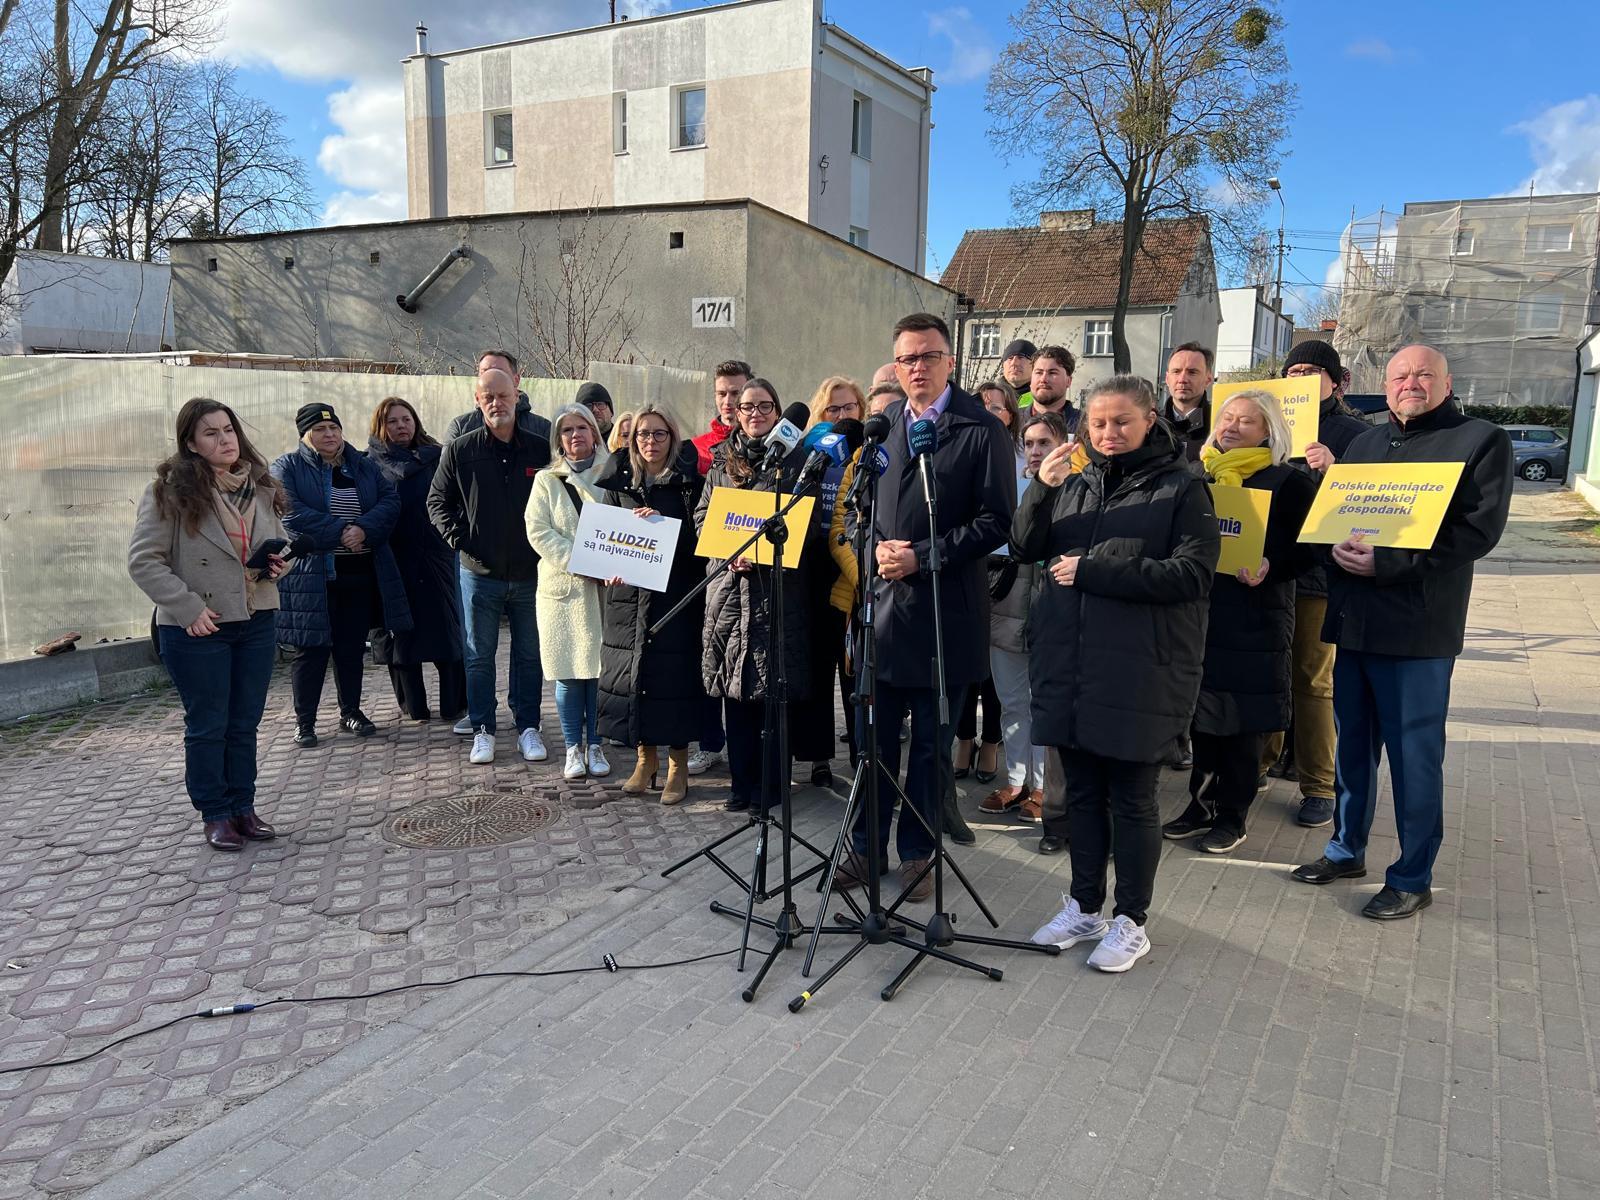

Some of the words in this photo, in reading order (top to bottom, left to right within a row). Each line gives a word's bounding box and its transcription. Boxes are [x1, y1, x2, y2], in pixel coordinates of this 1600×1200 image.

[696, 302, 731, 322] 17/1
[1283, 394, 1310, 404] kolei
[1329, 481, 1376, 491] Polskie
[1378, 482, 1444, 493] pieniądze
[1345, 493, 1361, 502] do
[1363, 493, 1418, 505] polskiej
[1338, 504, 1413, 515] gospodarki
[724, 511, 767, 529] Hołow
[594, 529, 606, 540] To
[608, 530, 658, 551] LUDZIE
[583, 540, 596, 552] są
[598, 543, 664, 564] najważniejsi
